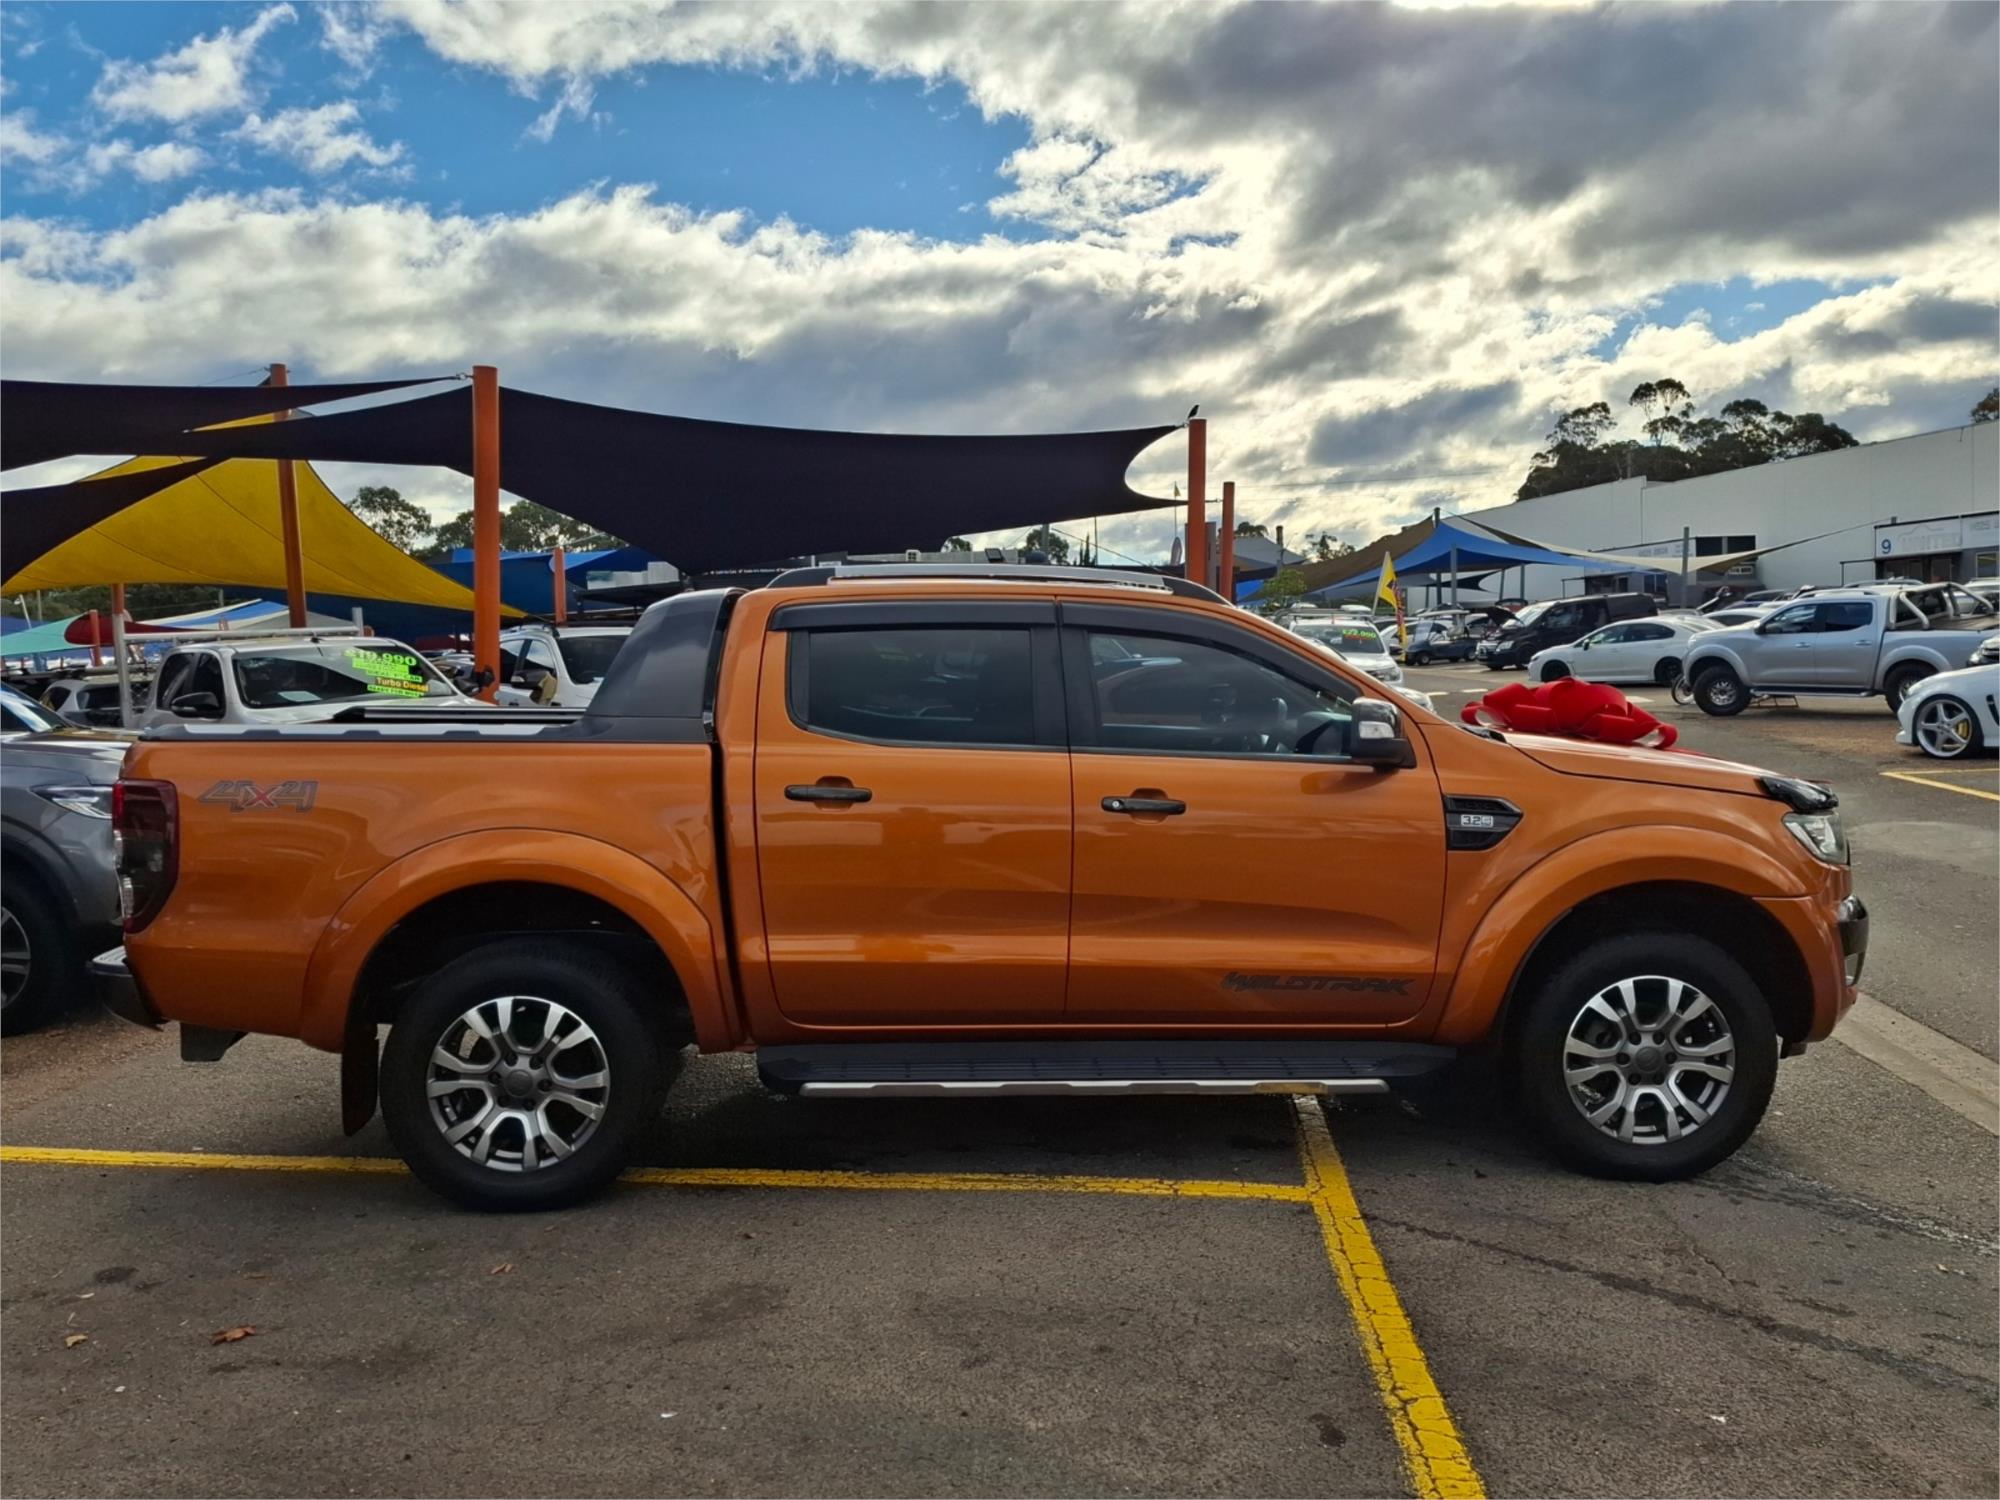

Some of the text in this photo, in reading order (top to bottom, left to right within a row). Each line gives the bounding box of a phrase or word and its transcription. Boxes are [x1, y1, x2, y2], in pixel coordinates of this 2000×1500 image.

[1881, 538, 1892, 555] 9
[376, 677, 401, 690] Turbo
[1220, 971, 1416, 996] WILDTRAK
